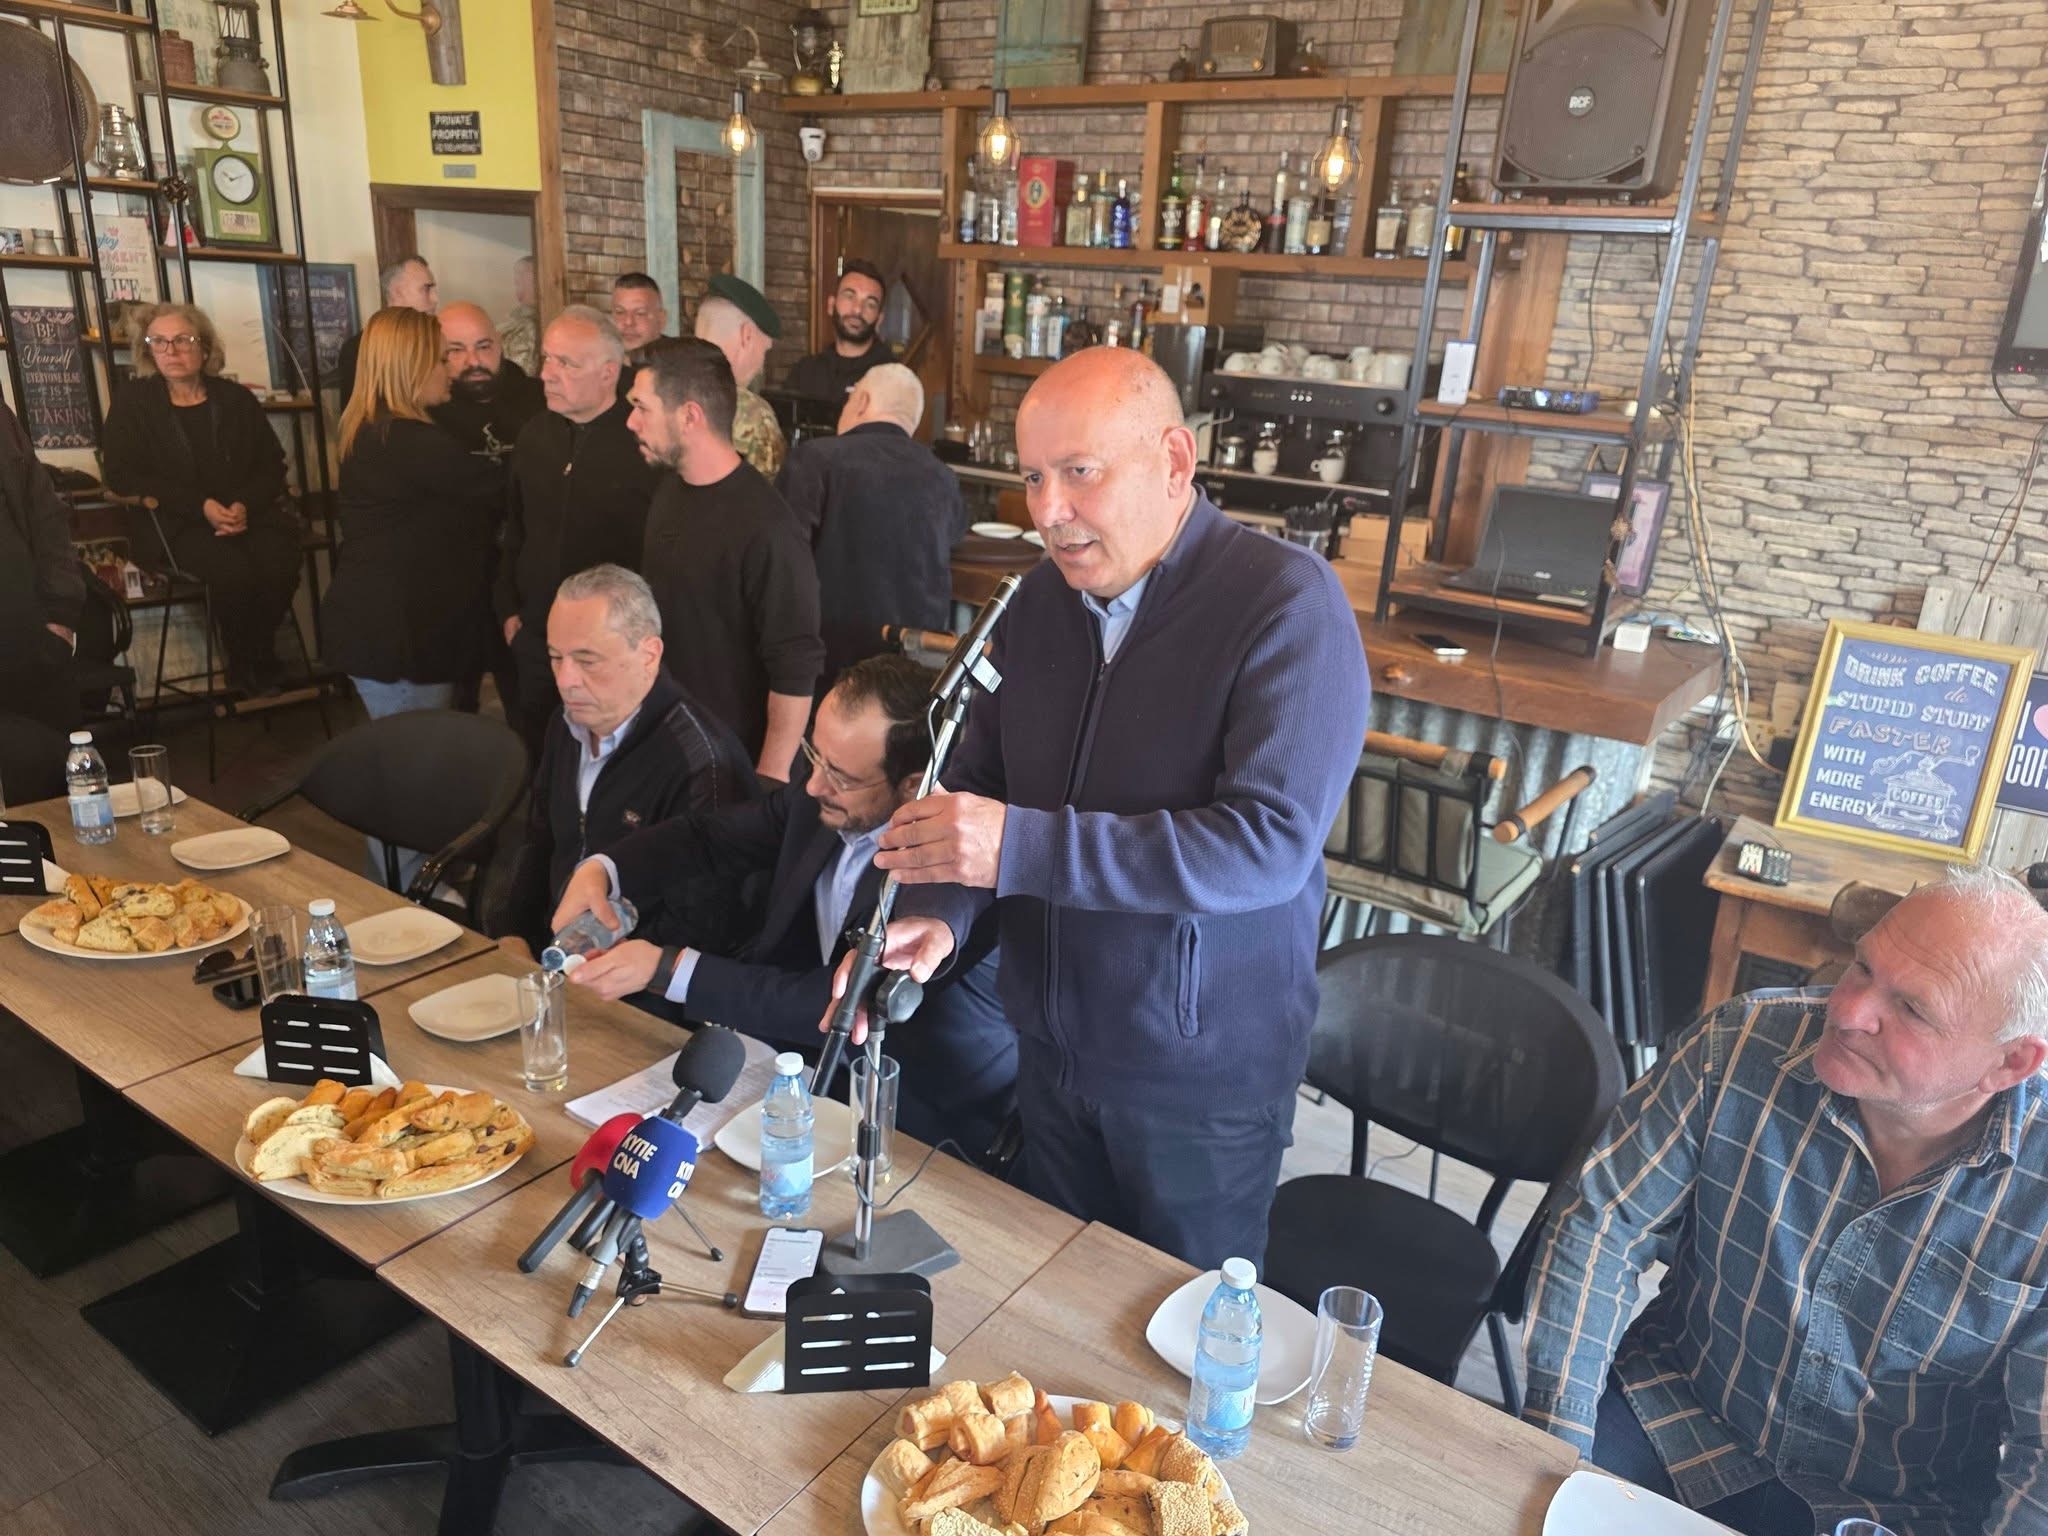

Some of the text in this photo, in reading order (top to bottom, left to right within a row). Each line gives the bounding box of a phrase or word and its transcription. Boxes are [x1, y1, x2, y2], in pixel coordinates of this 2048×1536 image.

[1569, 96, 1591, 109] RCF
[434, 114, 473, 126] PRIVATE
[432, 129, 480, 141] PROPERTY
[36, 322, 56, 338] BE
[1844, 655, 1907, 688] DRINK
[1914, 662, 1999, 697] COFFEE
[1836, 690, 1991, 733] STUPID STUFF
[1828, 717, 1951, 755] FASTER
[1823, 743, 1866, 766] WITH
[2005, 743, 2048, 790] COF
[1816, 767, 1864, 791] MORE
[1809, 791, 1878, 817] ENERGY
[1890, 788, 1944, 811] COFFEE
[613, 1151, 640, 1180] CNA
